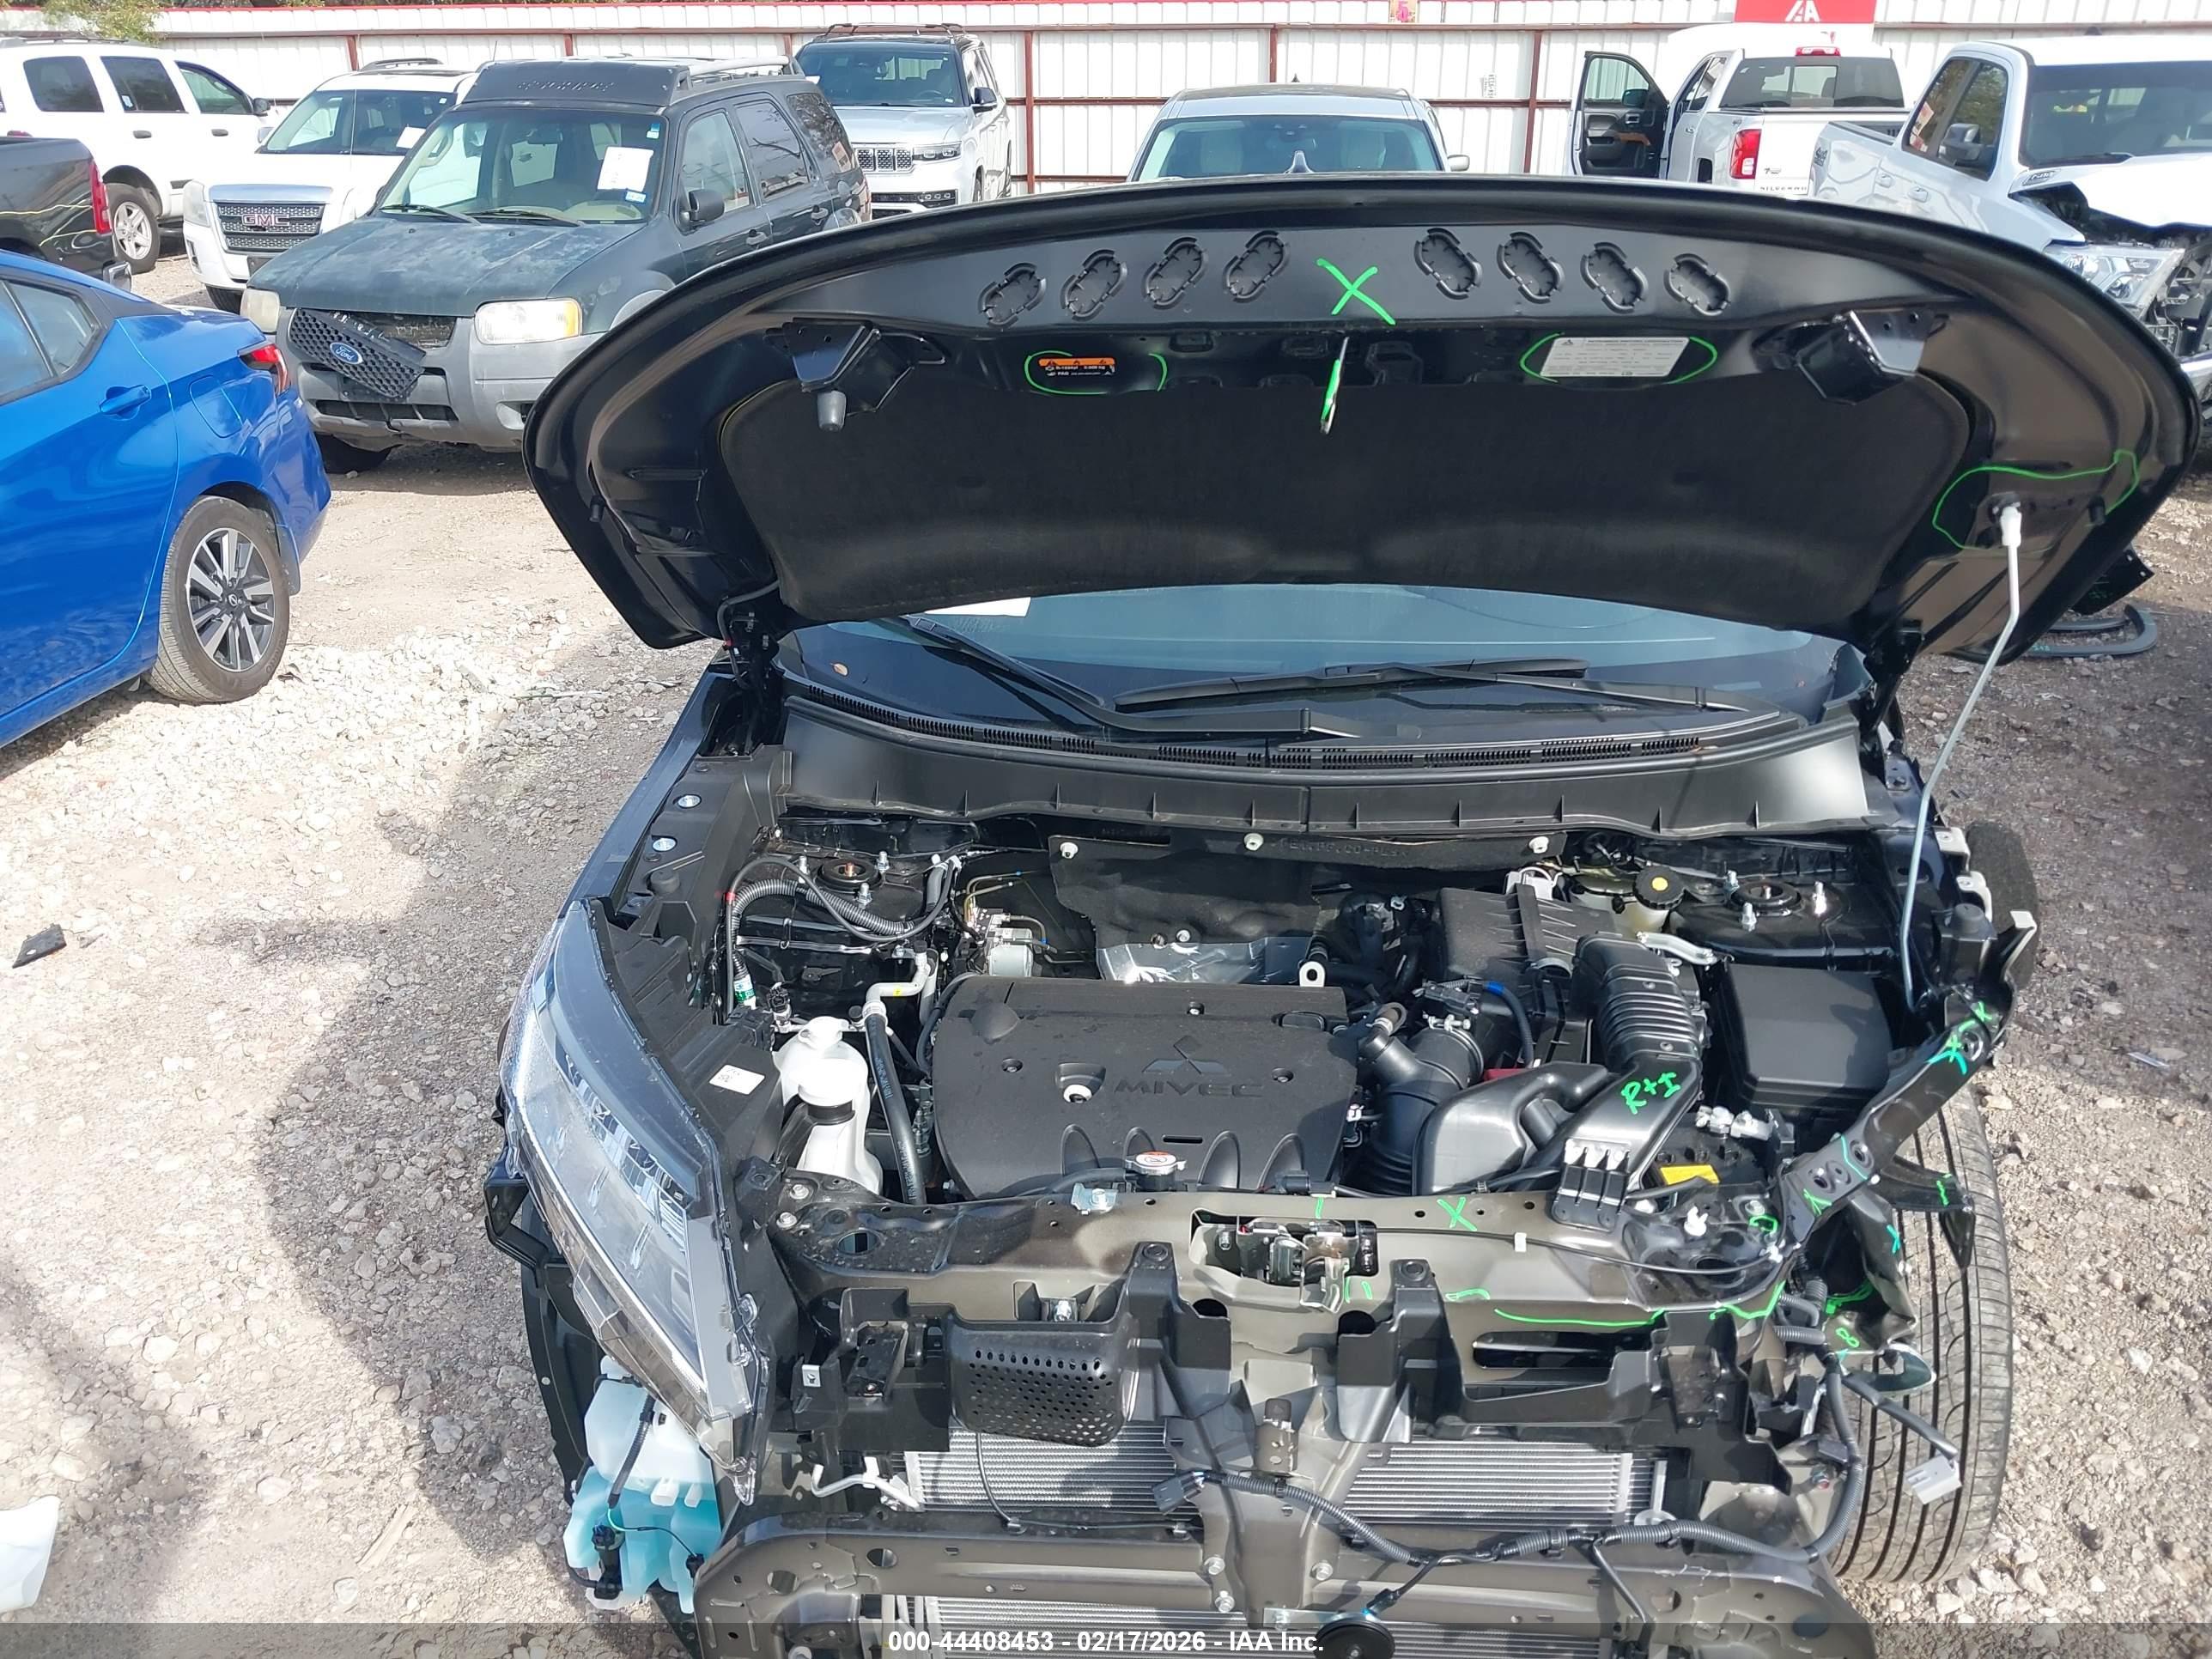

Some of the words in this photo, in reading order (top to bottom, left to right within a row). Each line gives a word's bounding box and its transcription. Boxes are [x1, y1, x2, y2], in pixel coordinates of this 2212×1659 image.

[241, 213, 290, 228] GMC
[335, 345, 356, 361] Ford
[1114, 1079, 1264, 1098] MIVEC
